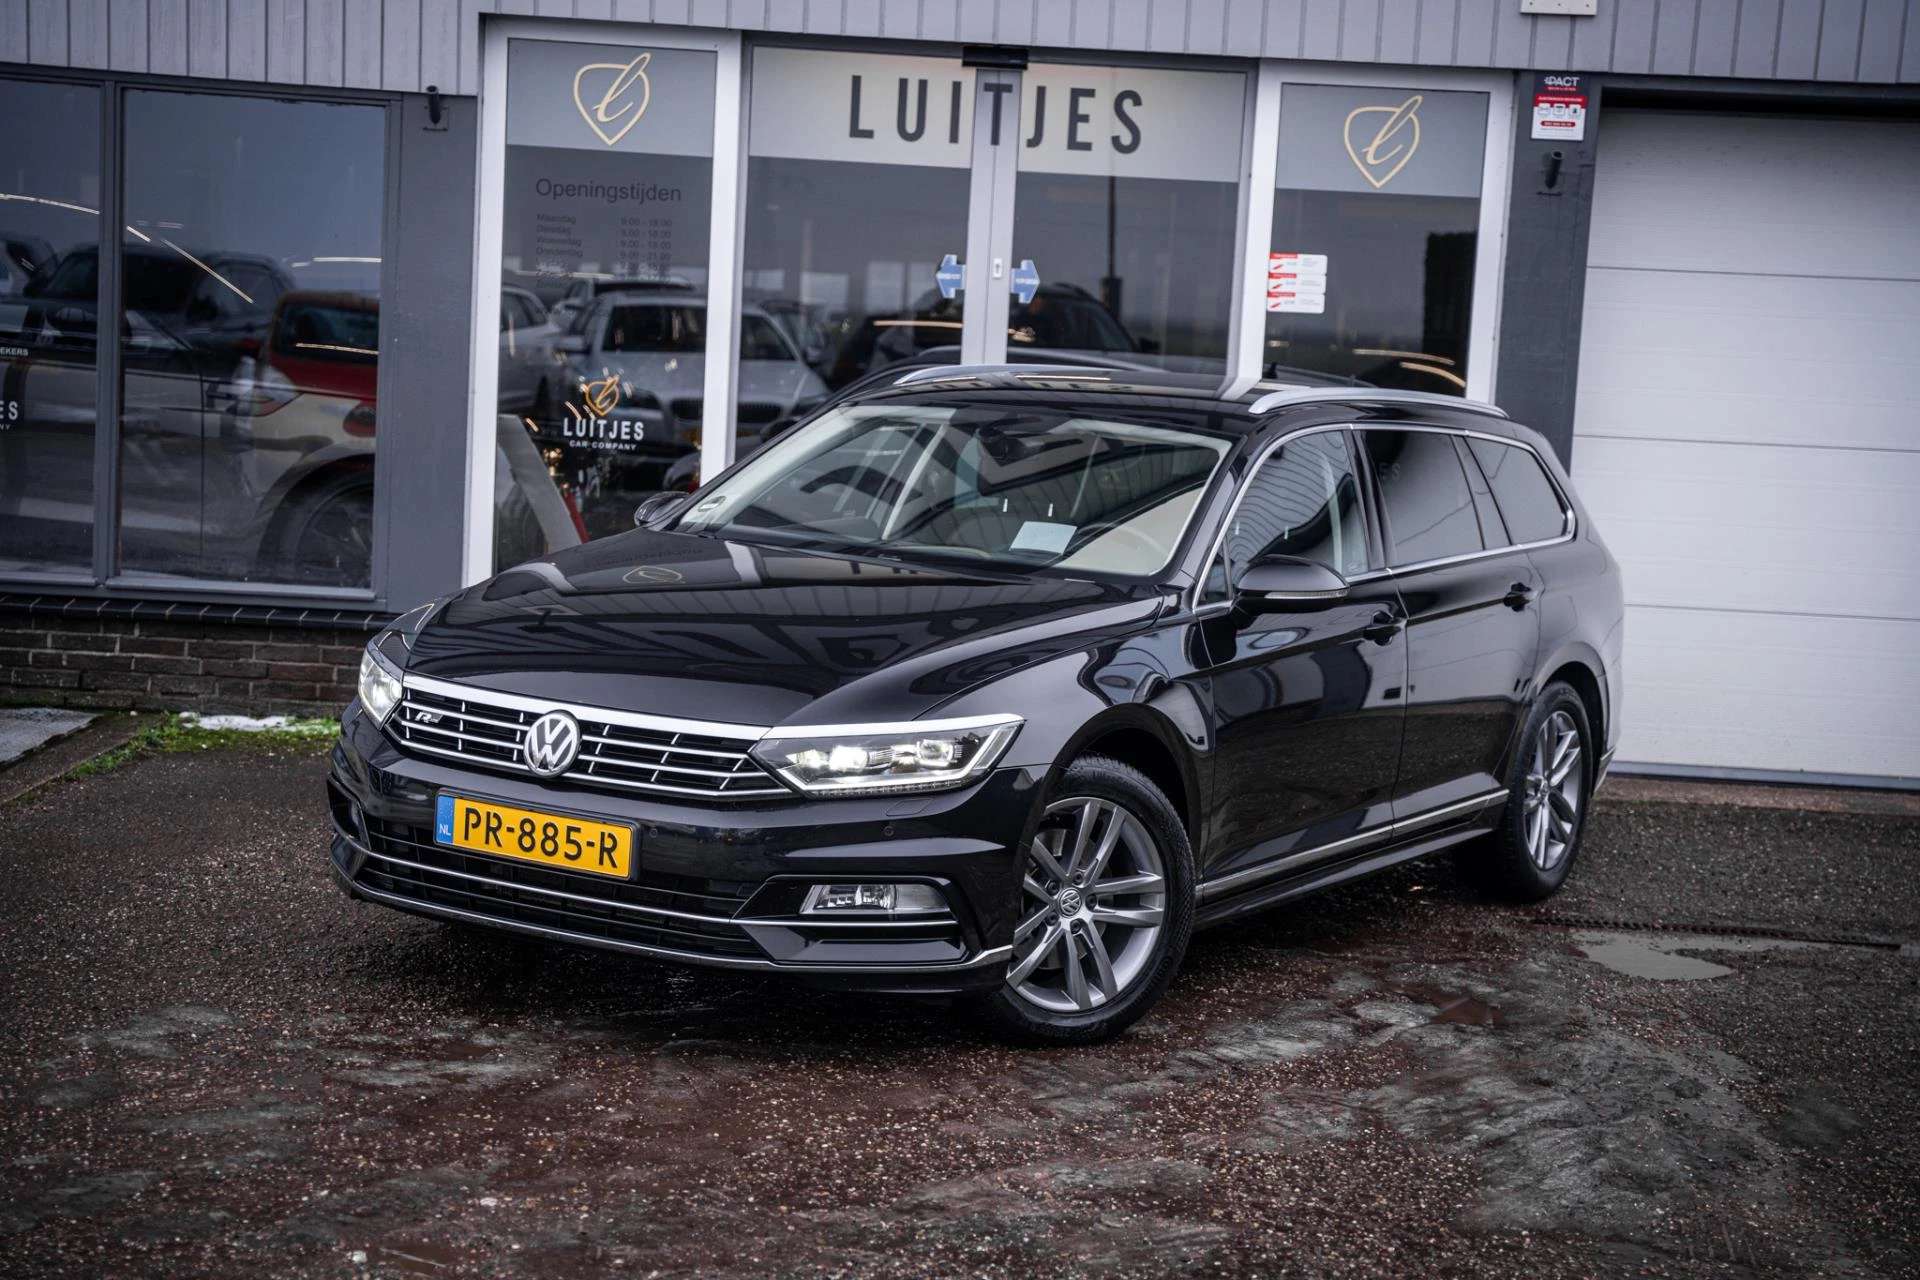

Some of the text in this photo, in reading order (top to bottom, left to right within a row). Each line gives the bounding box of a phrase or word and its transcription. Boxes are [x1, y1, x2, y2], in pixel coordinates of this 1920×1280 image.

[849, 75, 1143, 154] LUITJES
[536, 178, 681, 205] Openingstijden
[563, 418, 644, 441] LUITJES
[569, 440, 637, 451] CAR COMPANY
[439, 824, 452, 836] NL
[463, 807, 618, 869] PR-885-R
